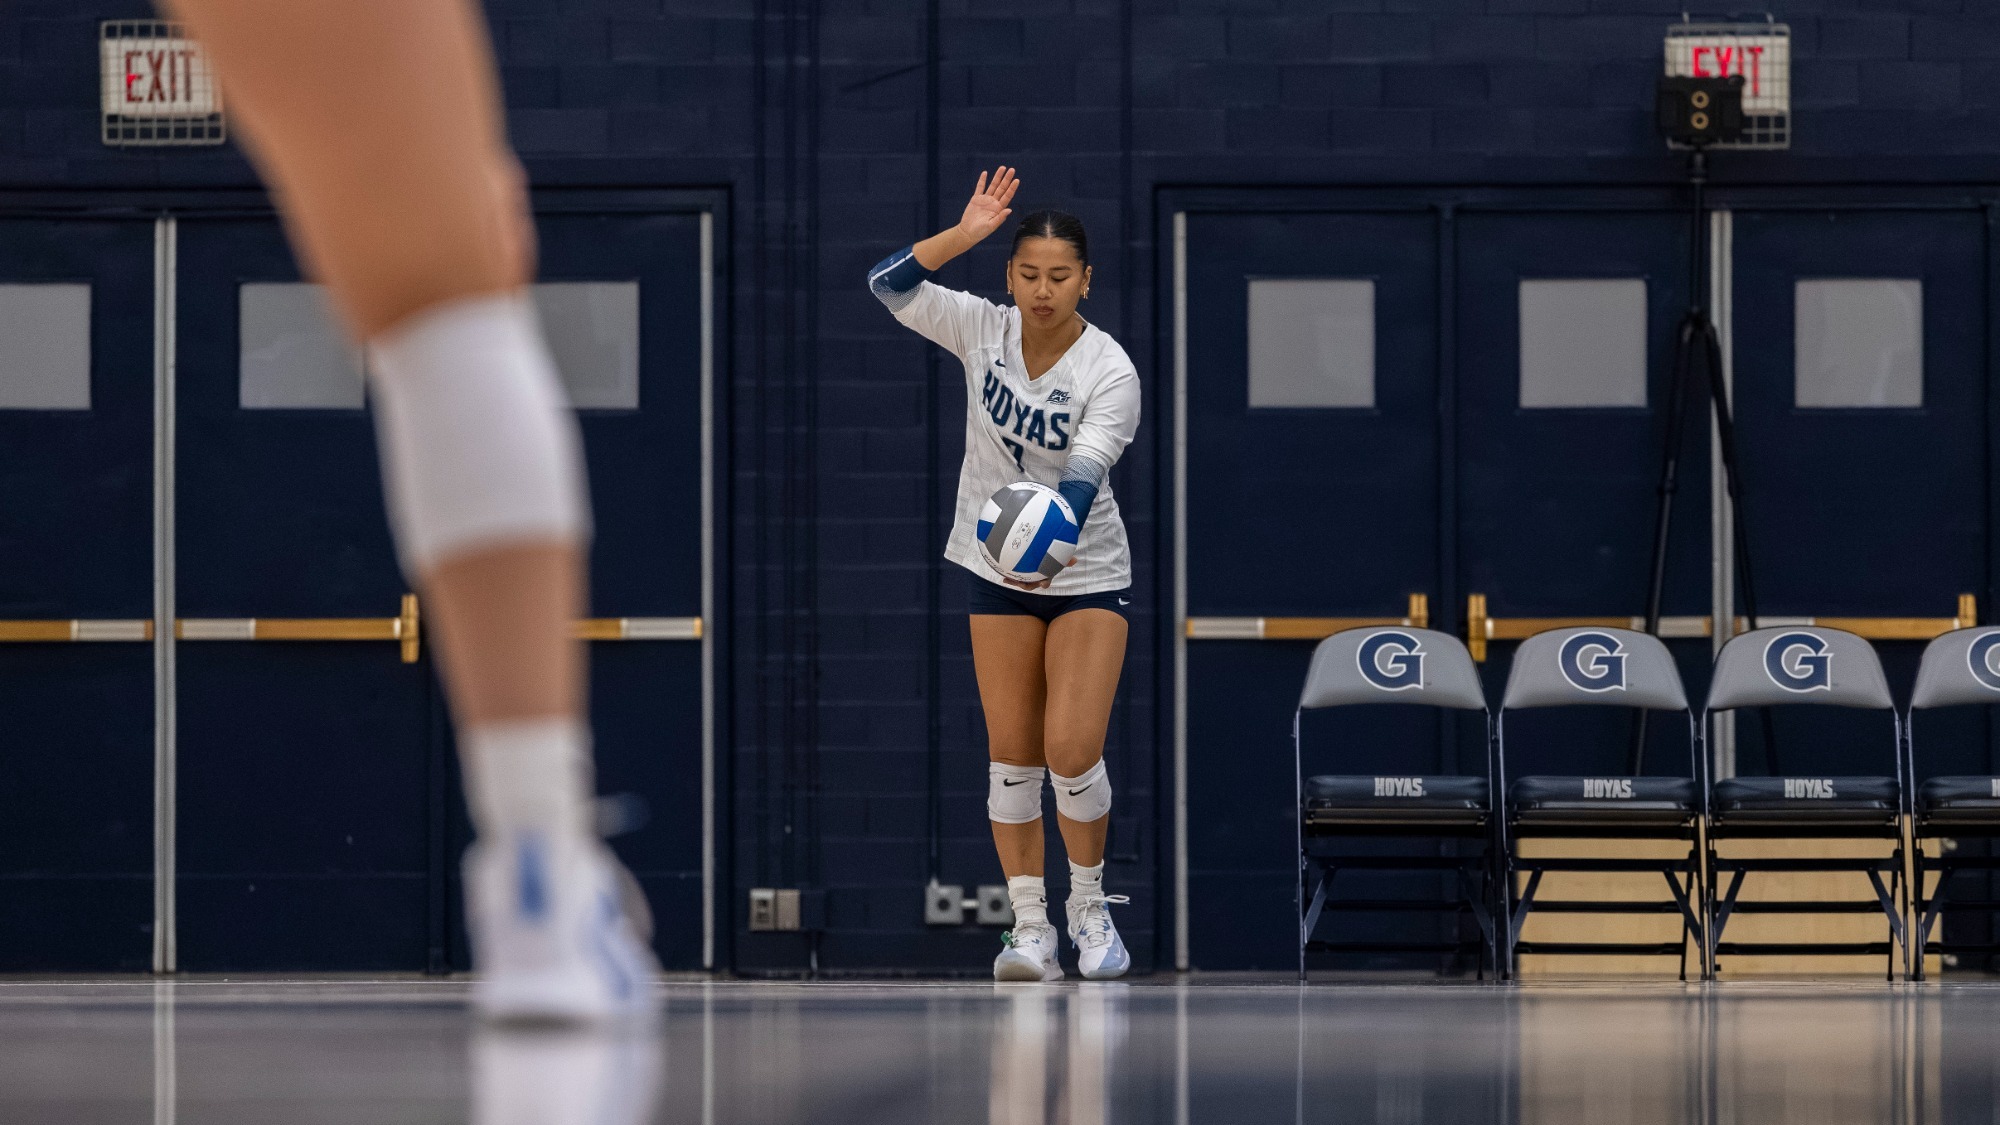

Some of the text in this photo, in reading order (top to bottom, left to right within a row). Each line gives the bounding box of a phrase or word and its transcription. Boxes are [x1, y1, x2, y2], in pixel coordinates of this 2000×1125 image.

[125, 50, 196, 102] EXIT
[983, 368, 1070, 451] HOYAS
[1356, 630, 1428, 692] G
[1558, 631, 1630, 693] G
[1762, 631, 1835, 693] G
[1374, 777, 1423, 797] HOYAS
[1583, 779, 1633, 799] HOYAS
[1784, 778, 1834, 798] HOYAS
